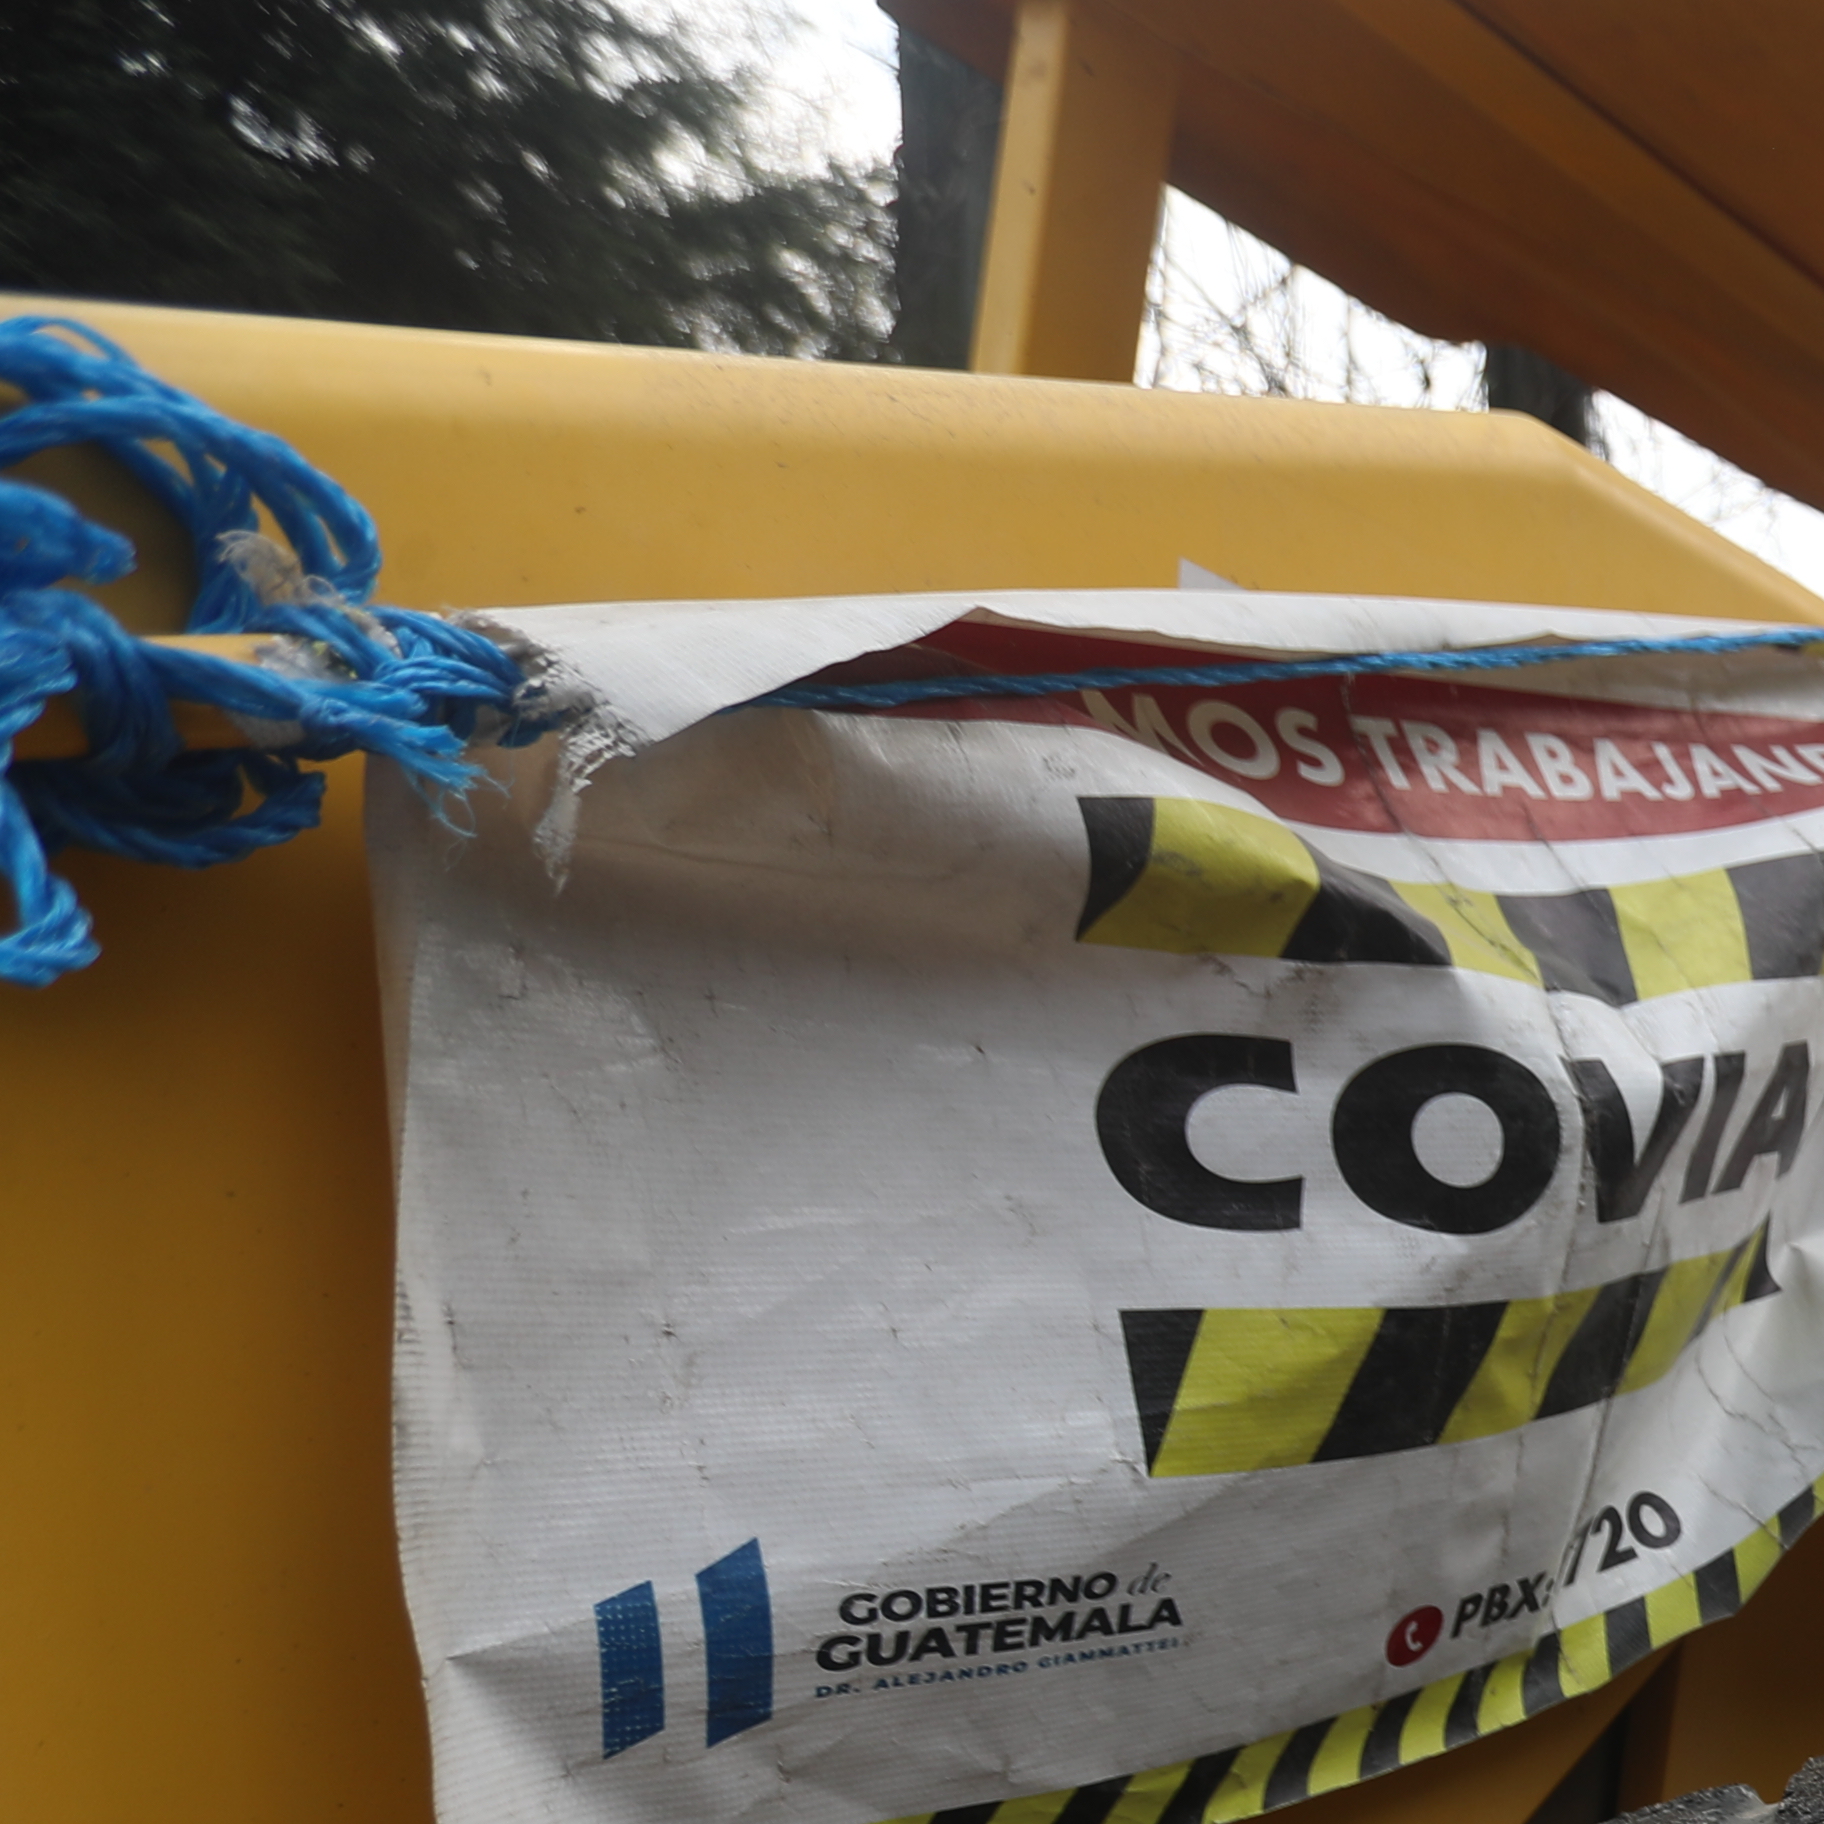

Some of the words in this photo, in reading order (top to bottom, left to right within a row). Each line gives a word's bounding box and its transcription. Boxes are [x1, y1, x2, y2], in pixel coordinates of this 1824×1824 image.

[839, 1571, 1119, 1626] GOBIERNO
[1126, 1561, 1173, 1596] de
[815, 1596, 1183, 1672] GUATEMALA
[814, 1682, 861, 1699] DR.
[872, 1662, 1029, 1690] ALEJANDRO
[1037, 1637, 1179, 1669] GIAMMATTEI
